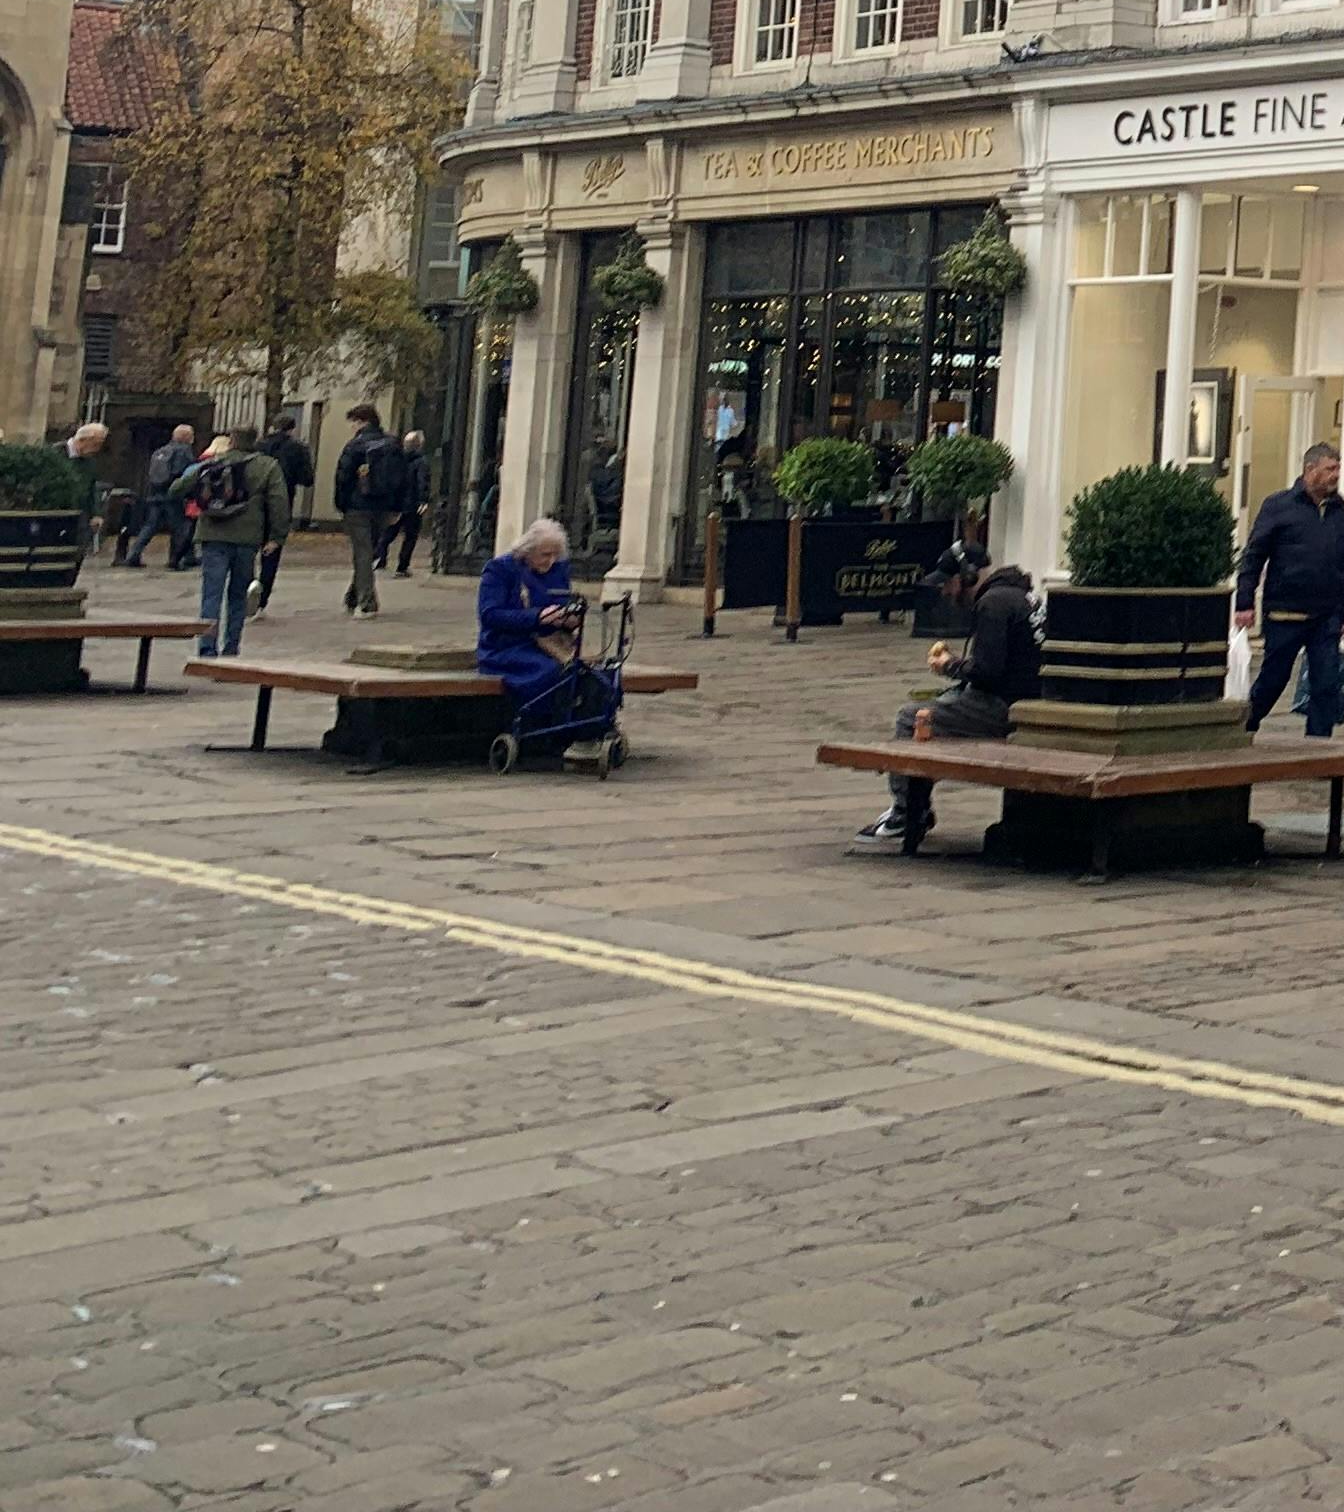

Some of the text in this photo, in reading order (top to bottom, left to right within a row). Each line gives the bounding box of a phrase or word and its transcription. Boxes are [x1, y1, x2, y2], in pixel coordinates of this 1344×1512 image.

[1113, 101, 1237, 146] CASTLE
[1253, 92, 1328, 134] FINE
[702, 126, 996, 181] TEA & COFFEE MERCHANTS
